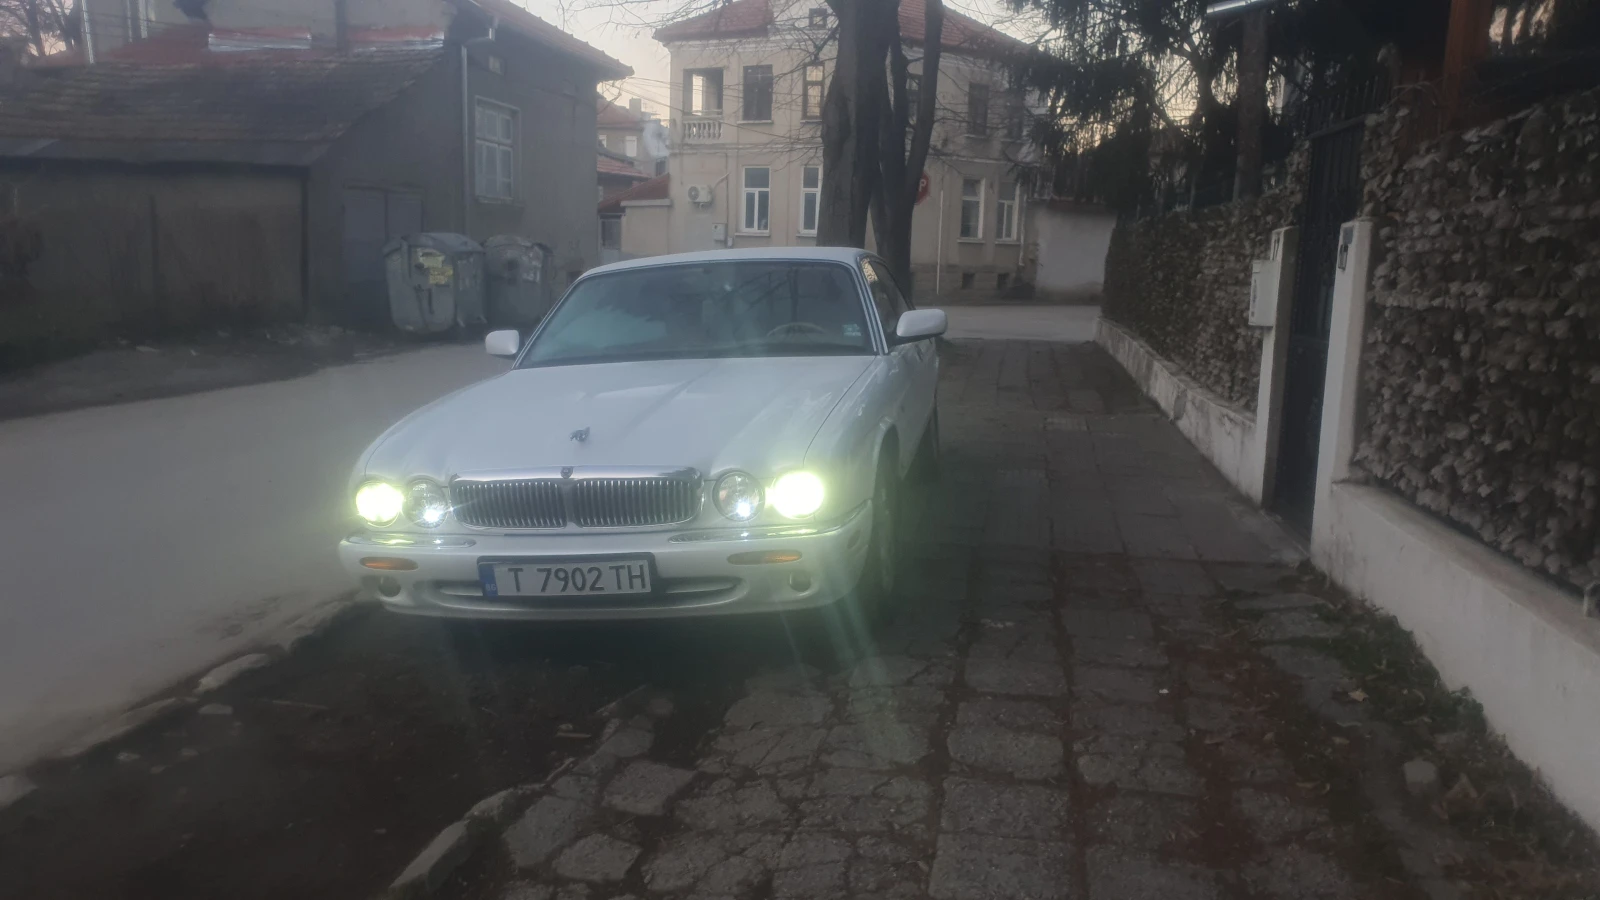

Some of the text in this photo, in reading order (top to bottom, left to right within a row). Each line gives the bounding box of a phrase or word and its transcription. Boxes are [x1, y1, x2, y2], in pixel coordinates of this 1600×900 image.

[507, 564, 646, 592] T 7902 TH
